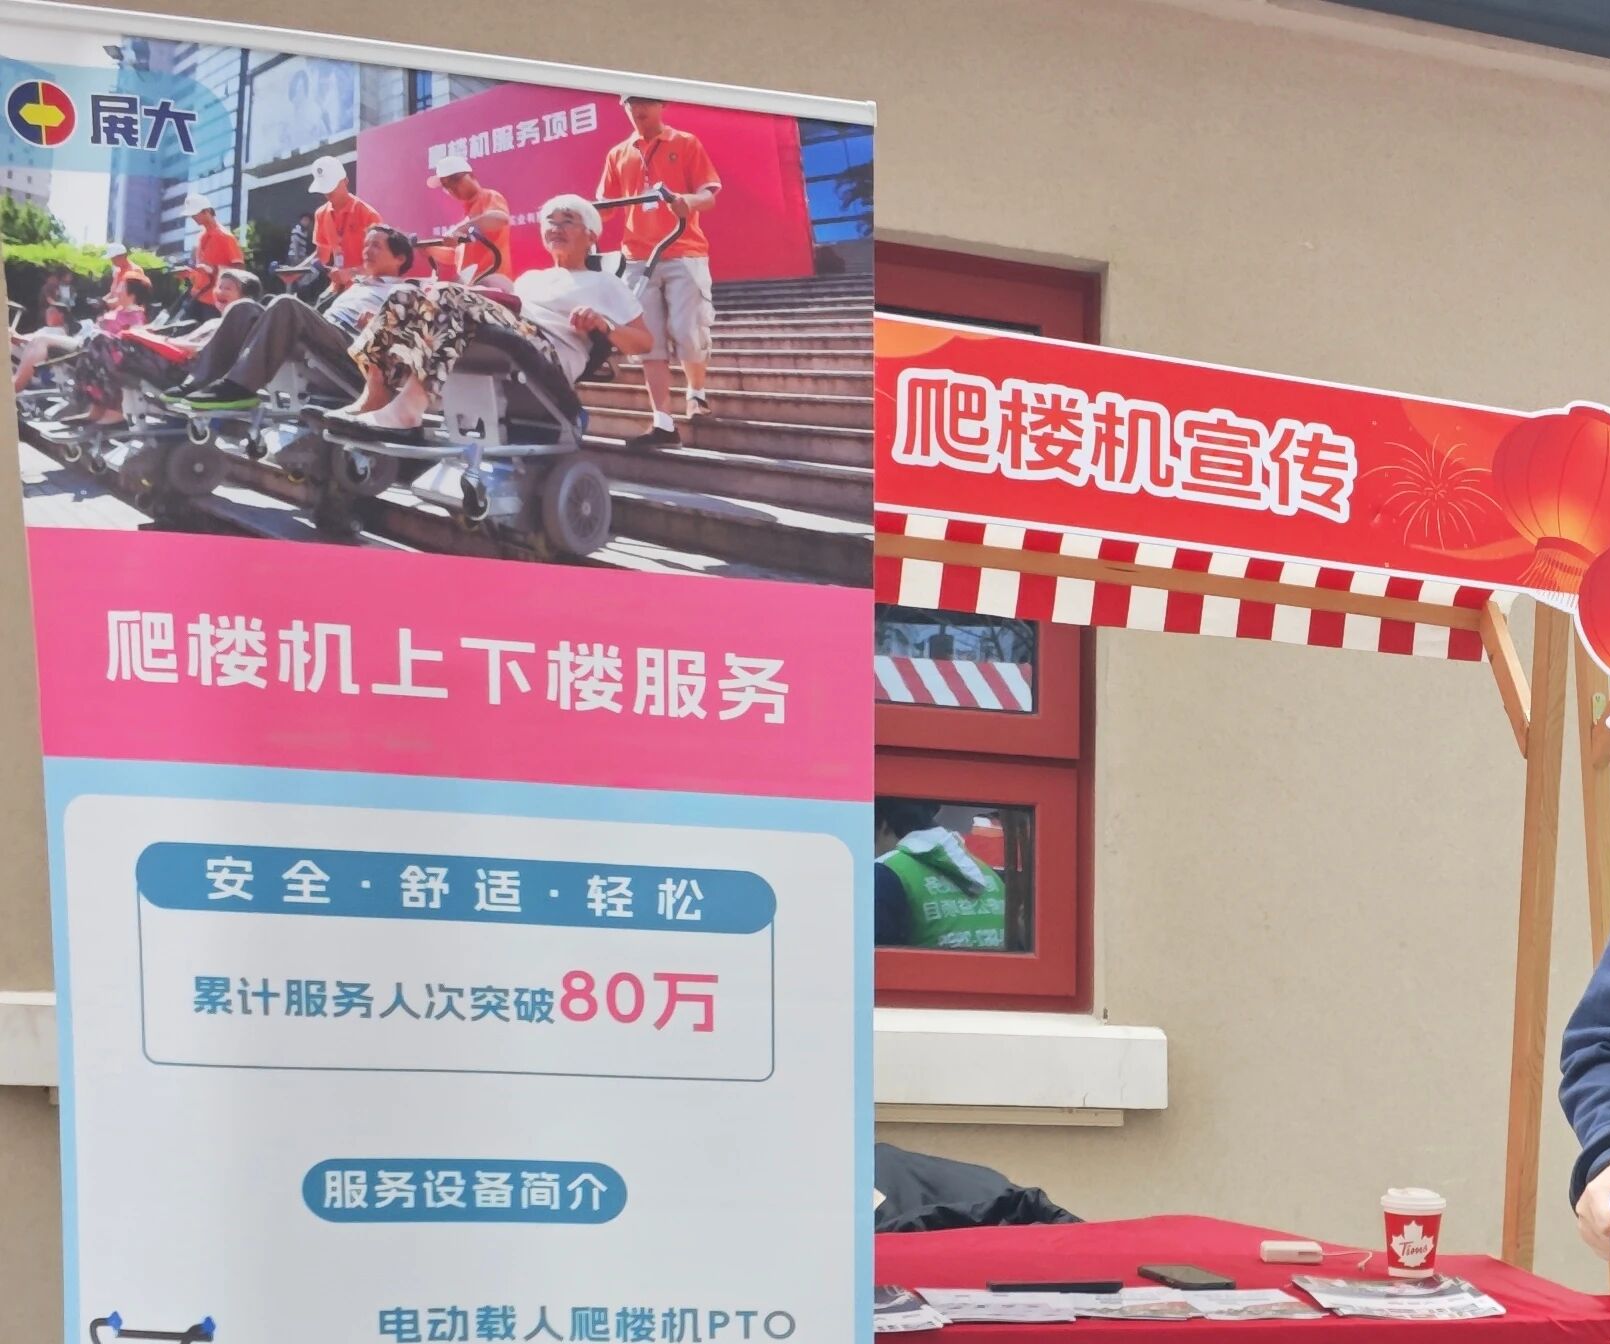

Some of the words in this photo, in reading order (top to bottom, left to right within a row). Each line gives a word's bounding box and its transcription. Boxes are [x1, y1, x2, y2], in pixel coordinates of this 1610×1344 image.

[91, 94, 196, 153] 展大
[899, 374, 1355, 521] 爬楼机宣传
[105, 609, 790, 725] 爬楼机上下楼服务
[192, 970, 720, 1034] 累计服务人次突破80万
[322, 1169, 608, 1212] 服务设备简介
[378, 1304, 796, 1344] 电动载人爬楼机PTO
